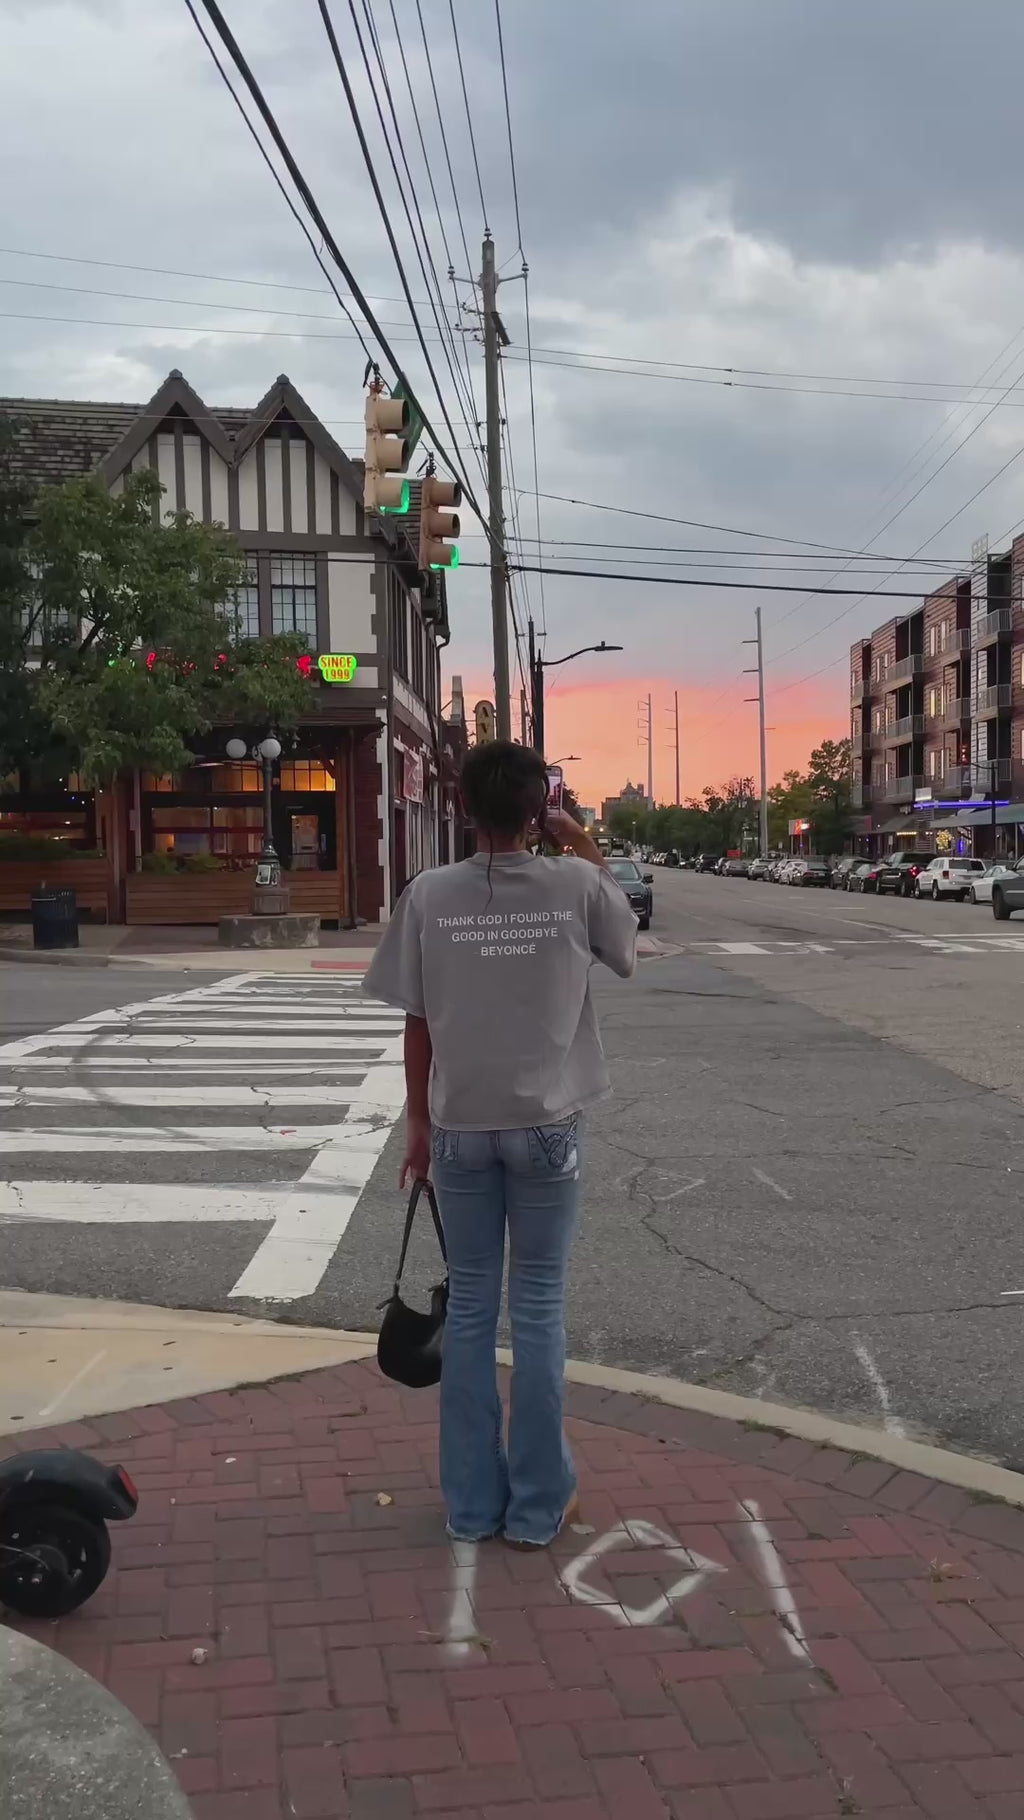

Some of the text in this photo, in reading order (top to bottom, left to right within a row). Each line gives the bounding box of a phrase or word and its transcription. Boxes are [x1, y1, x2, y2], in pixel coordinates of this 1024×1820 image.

[320, 656, 352, 668] SINCE
[325, 669, 350, 680] 1999
[437, 911, 573, 927] THANK GOD I FOUND THE
[451, 927, 558, 942] GOOD IN GOODBYE
[480, 943, 536, 956] BEYONCÉ
